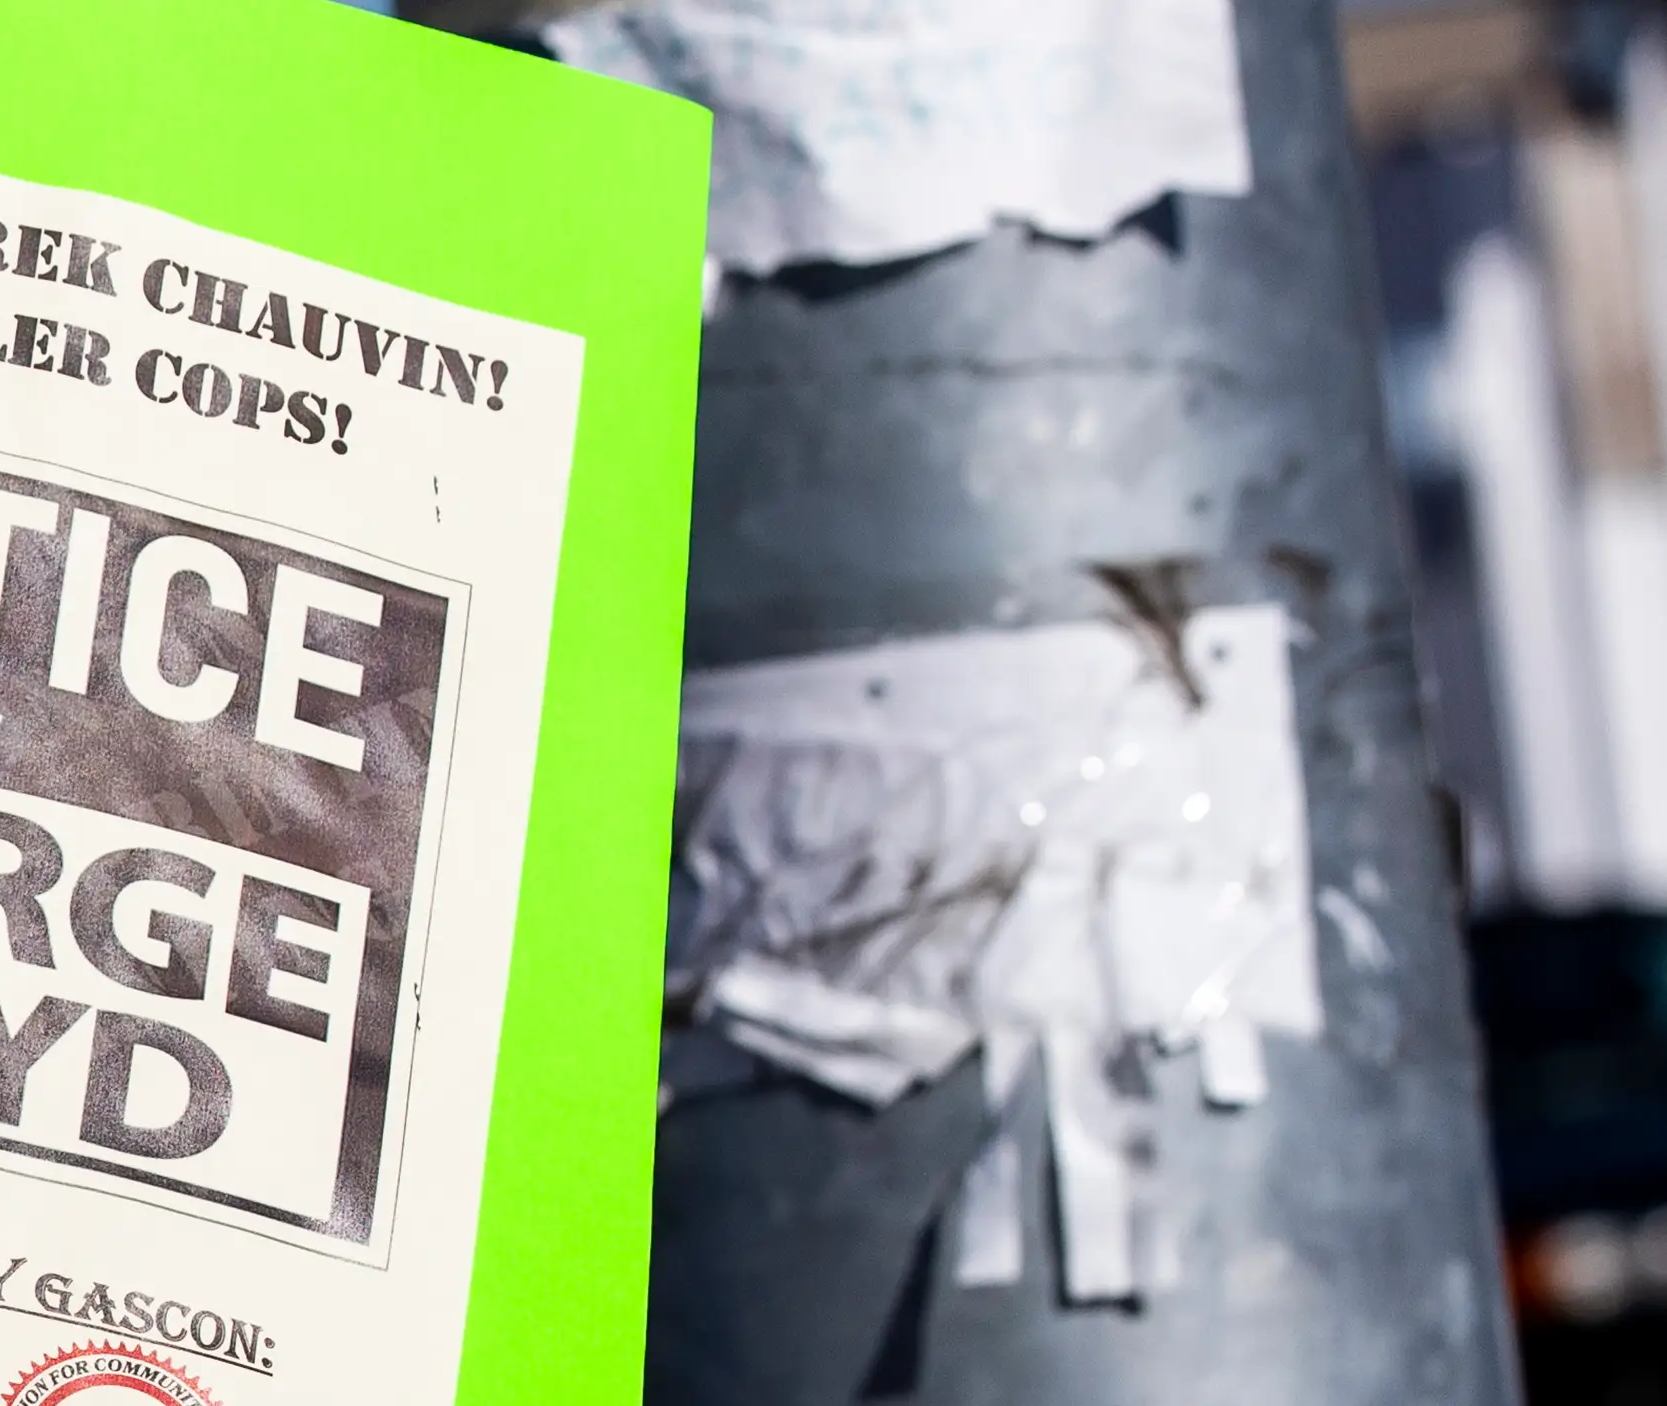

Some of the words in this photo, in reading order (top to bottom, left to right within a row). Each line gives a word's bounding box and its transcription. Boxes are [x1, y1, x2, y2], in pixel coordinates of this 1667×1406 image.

[142, 258, 510, 412] CHAUVIN!
[135, 349, 354, 455] COPS!
[34, 1271, 276, 1370] GASCON:
[49, 1360, 89, 1388] FOR
